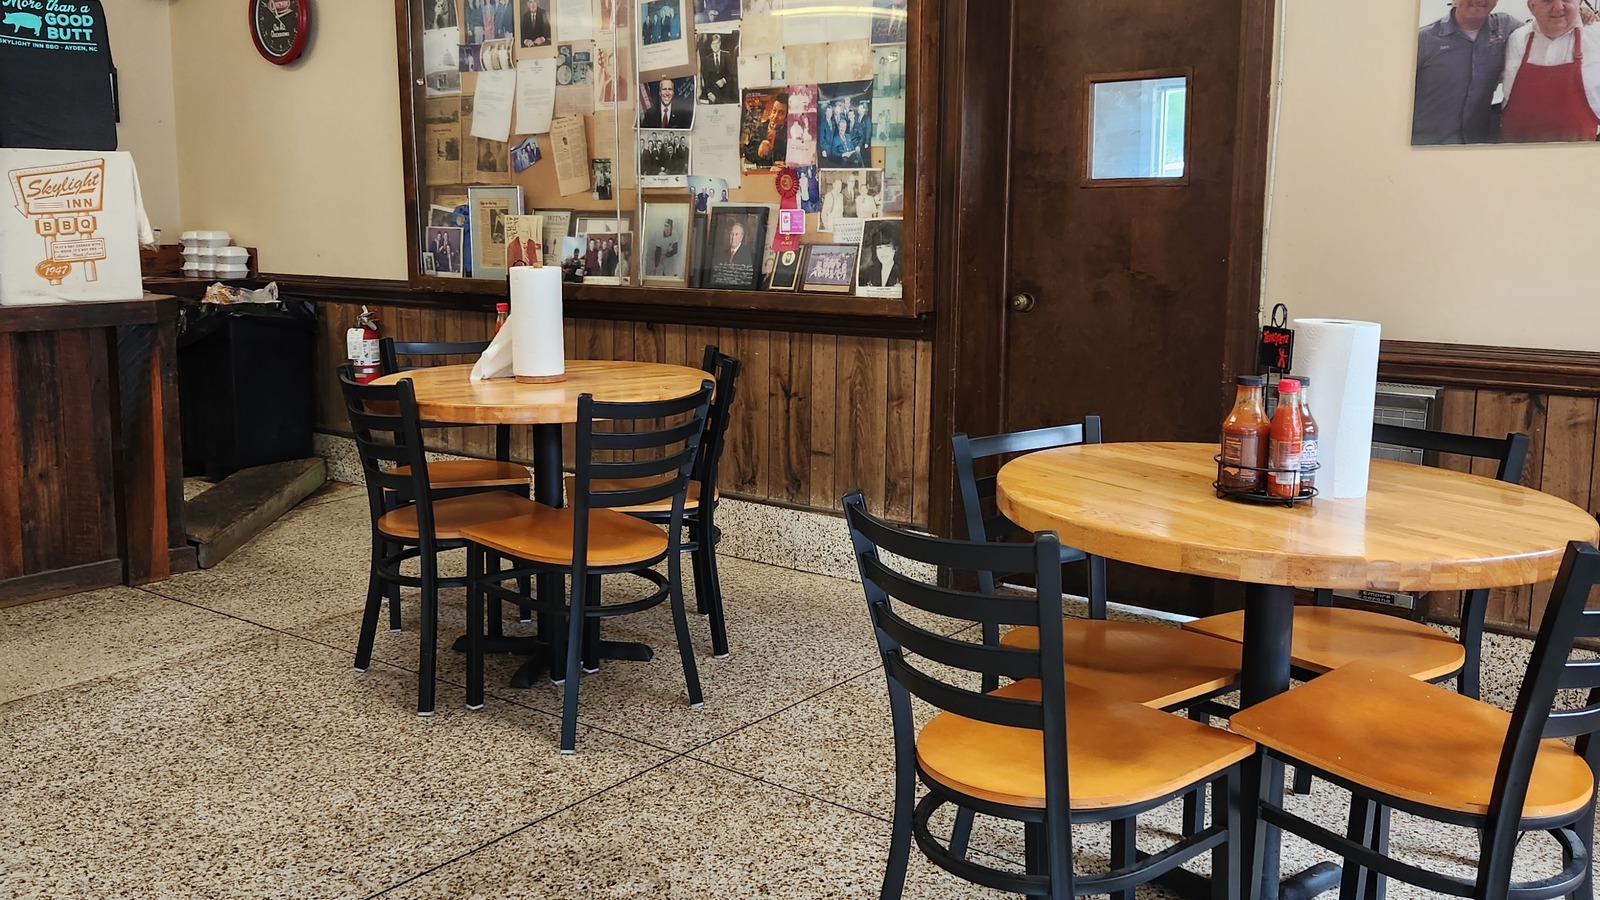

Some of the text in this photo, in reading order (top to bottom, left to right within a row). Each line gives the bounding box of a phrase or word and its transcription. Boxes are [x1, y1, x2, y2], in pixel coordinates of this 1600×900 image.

[2, 0, 90, 13] More than a
[45, 13, 94, 27] GOOD
[47, 27, 93, 40] BUTT
[27, 171, 100, 198] Skylight
[67, 199, 93, 209] INN
[43, 219, 91, 232] BBQ
[45, 265, 68, 276] 1947
